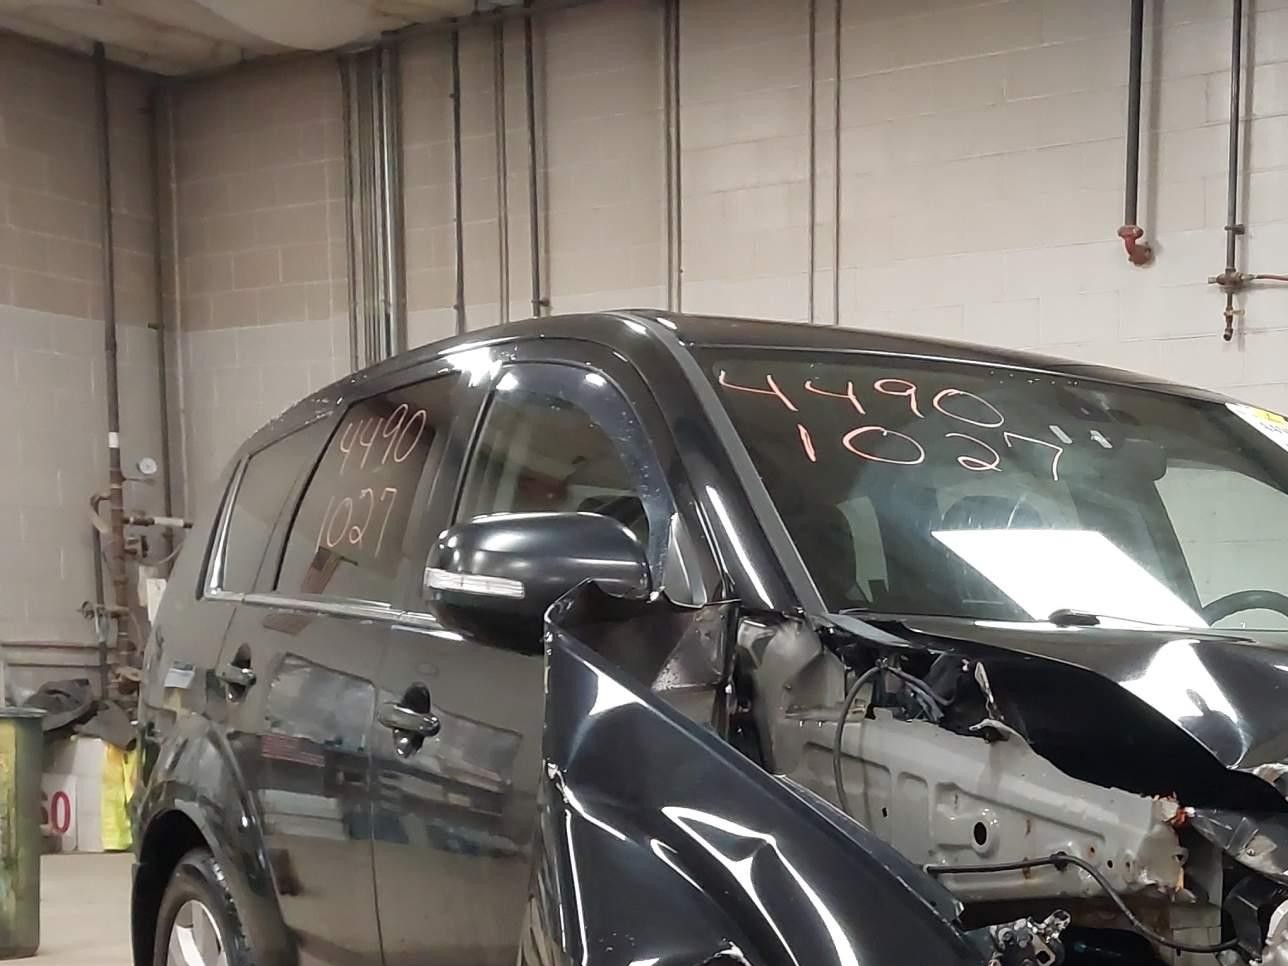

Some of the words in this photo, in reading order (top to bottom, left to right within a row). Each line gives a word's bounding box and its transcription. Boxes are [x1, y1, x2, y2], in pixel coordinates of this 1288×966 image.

[719, 369, 1005, 428] 4490
[339, 403, 427, 476] 4490
[797, 424, 1064, 481] 1027
[314, 487, 398, 558] 1027
